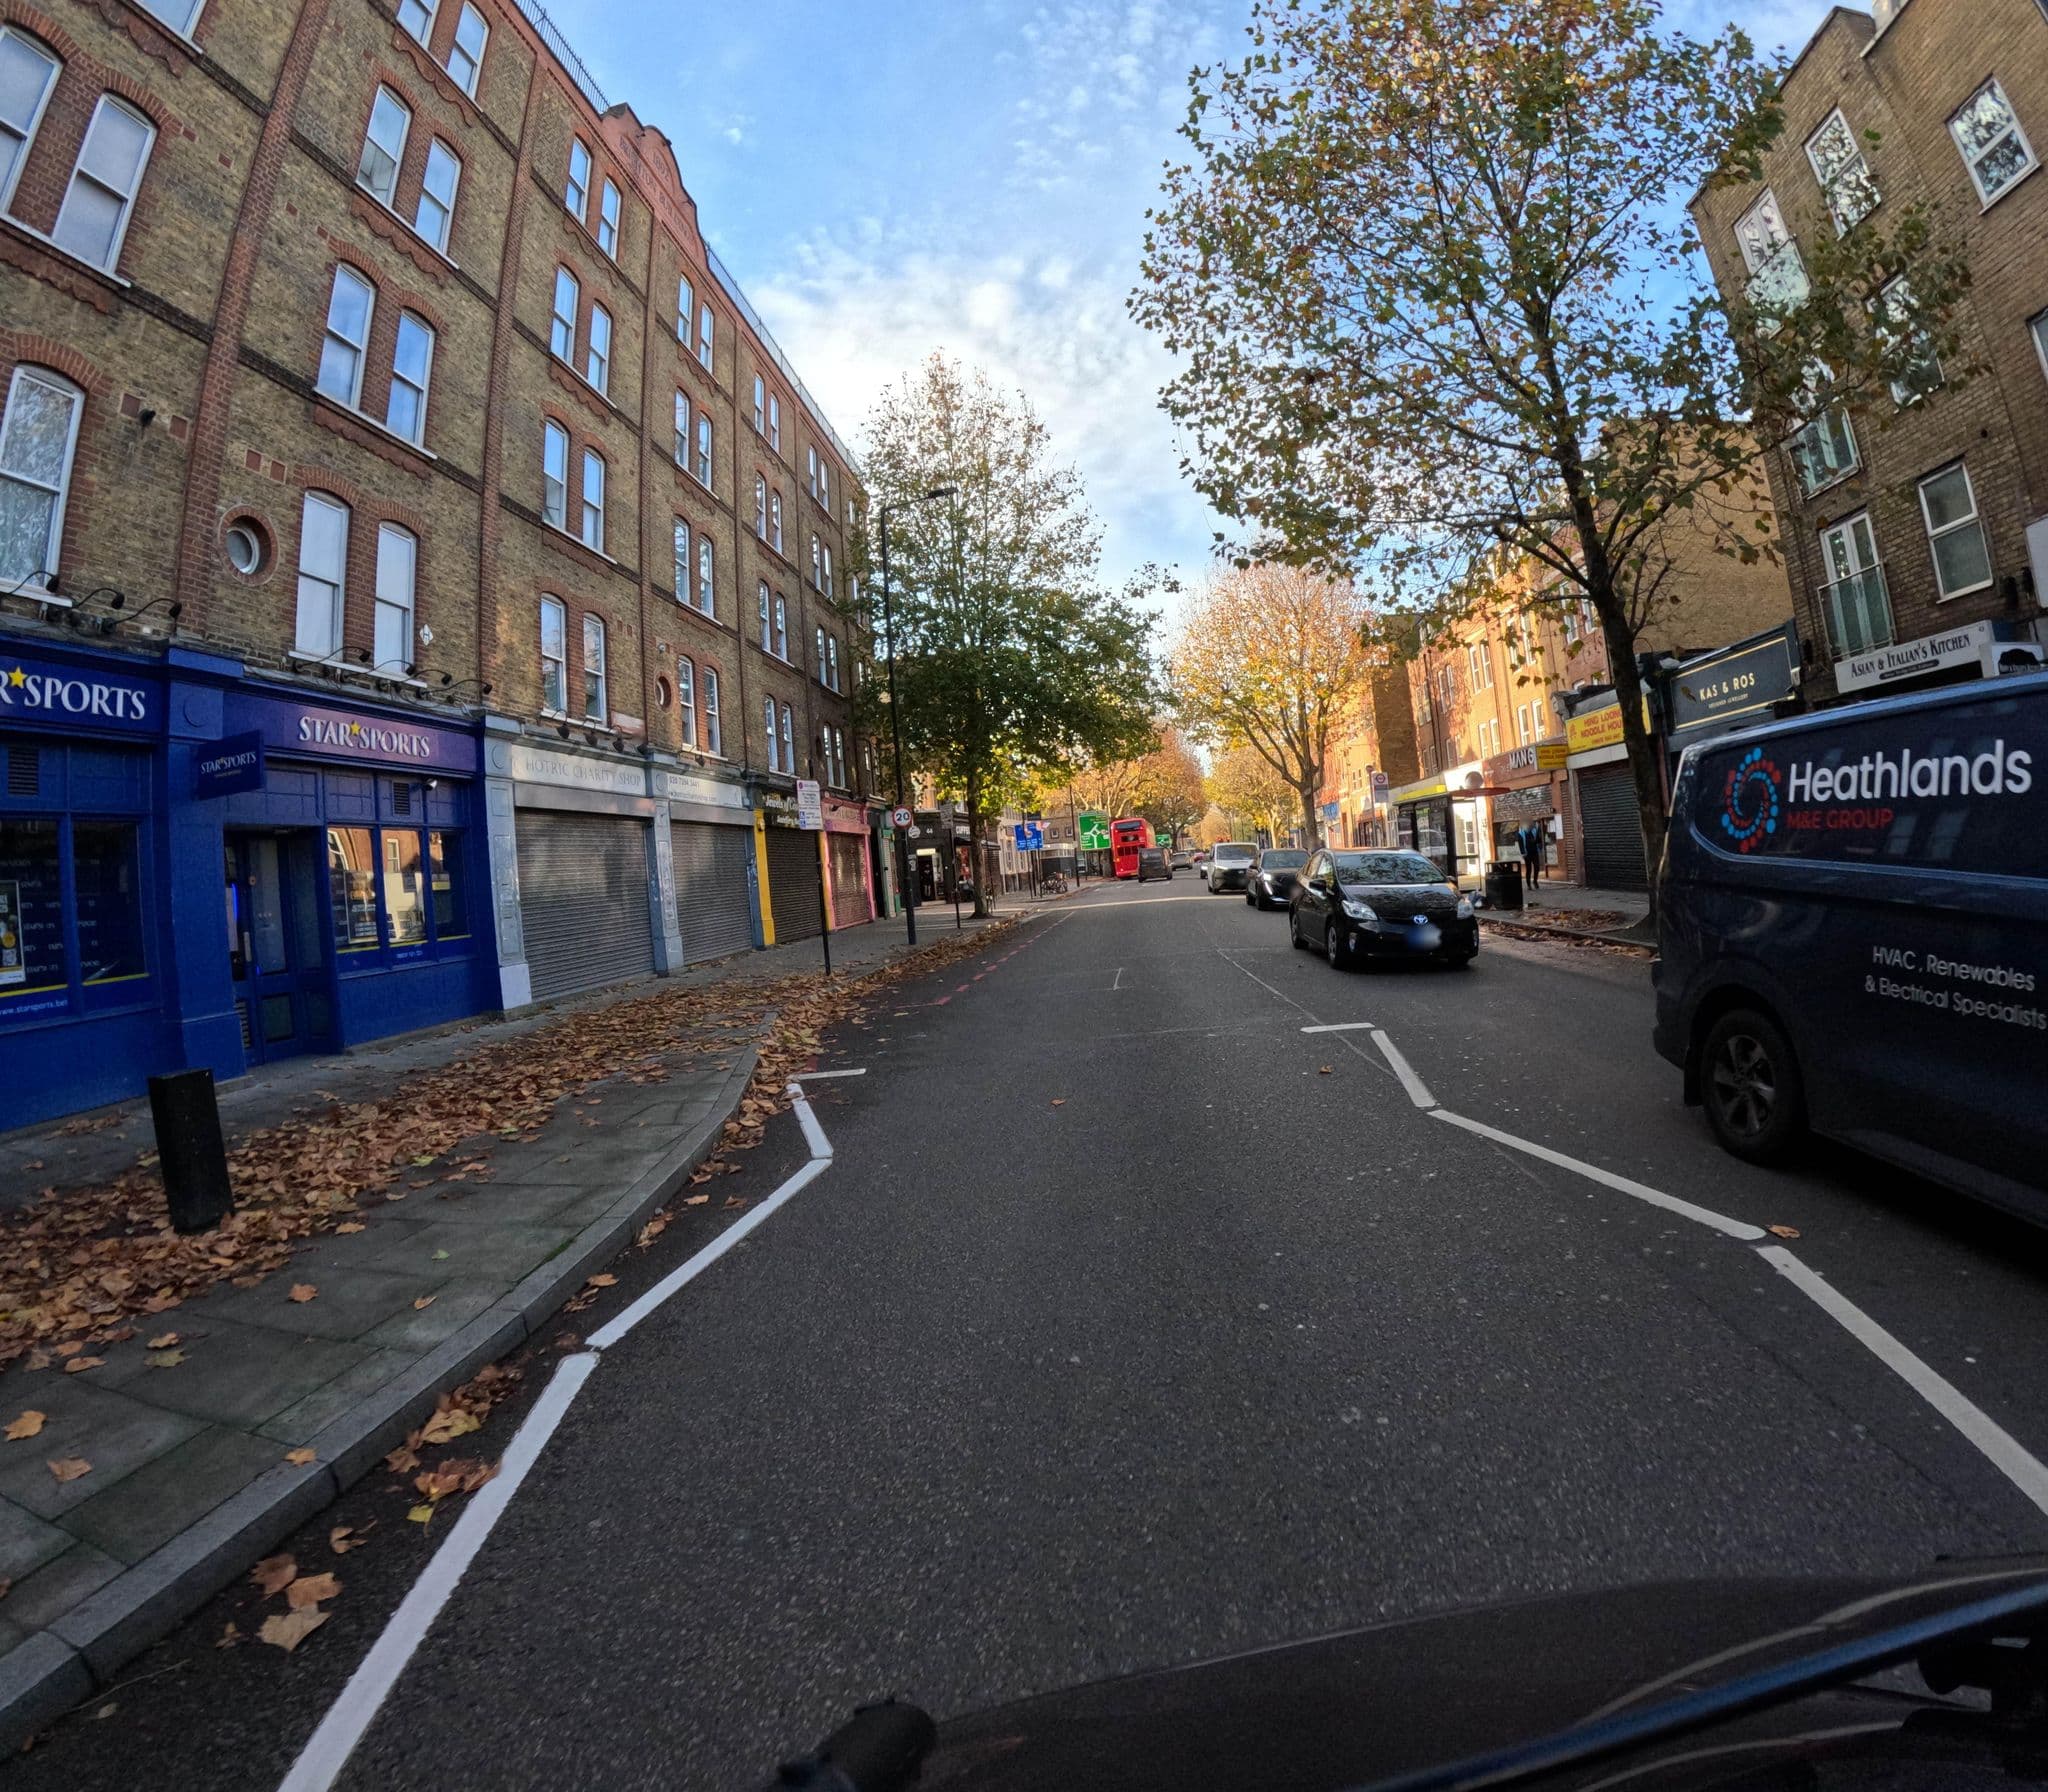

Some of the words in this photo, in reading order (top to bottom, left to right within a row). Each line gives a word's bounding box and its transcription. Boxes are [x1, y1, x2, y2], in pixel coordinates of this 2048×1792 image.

[1878, 659, 1885, 671] &
[24, 674, 146, 720] SPORTS
[1699, 684, 1718, 701] KAS
[1733, 672, 1755, 690] ROS
[299, 716, 354, 748] STAR
[359, 726, 431, 758] SPORTS
[200, 760, 221, 775] STAR
[221, 750, 257, 769] SPORTS
[1788, 739, 2032, 803] Heathlands
[619, 772, 642, 788] SHOP
[896, 811, 910, 822] 20
[1786, 811, 1821, 829] M&E
[1826, 807, 1895, 828] GROUP
[1927, 954, 2036, 992] Renewables
[1864, 974, 1876, 993] &
[1879, 977, 1949, 1009] Electrical
[1952, 991, 2048, 1031] Specialists
